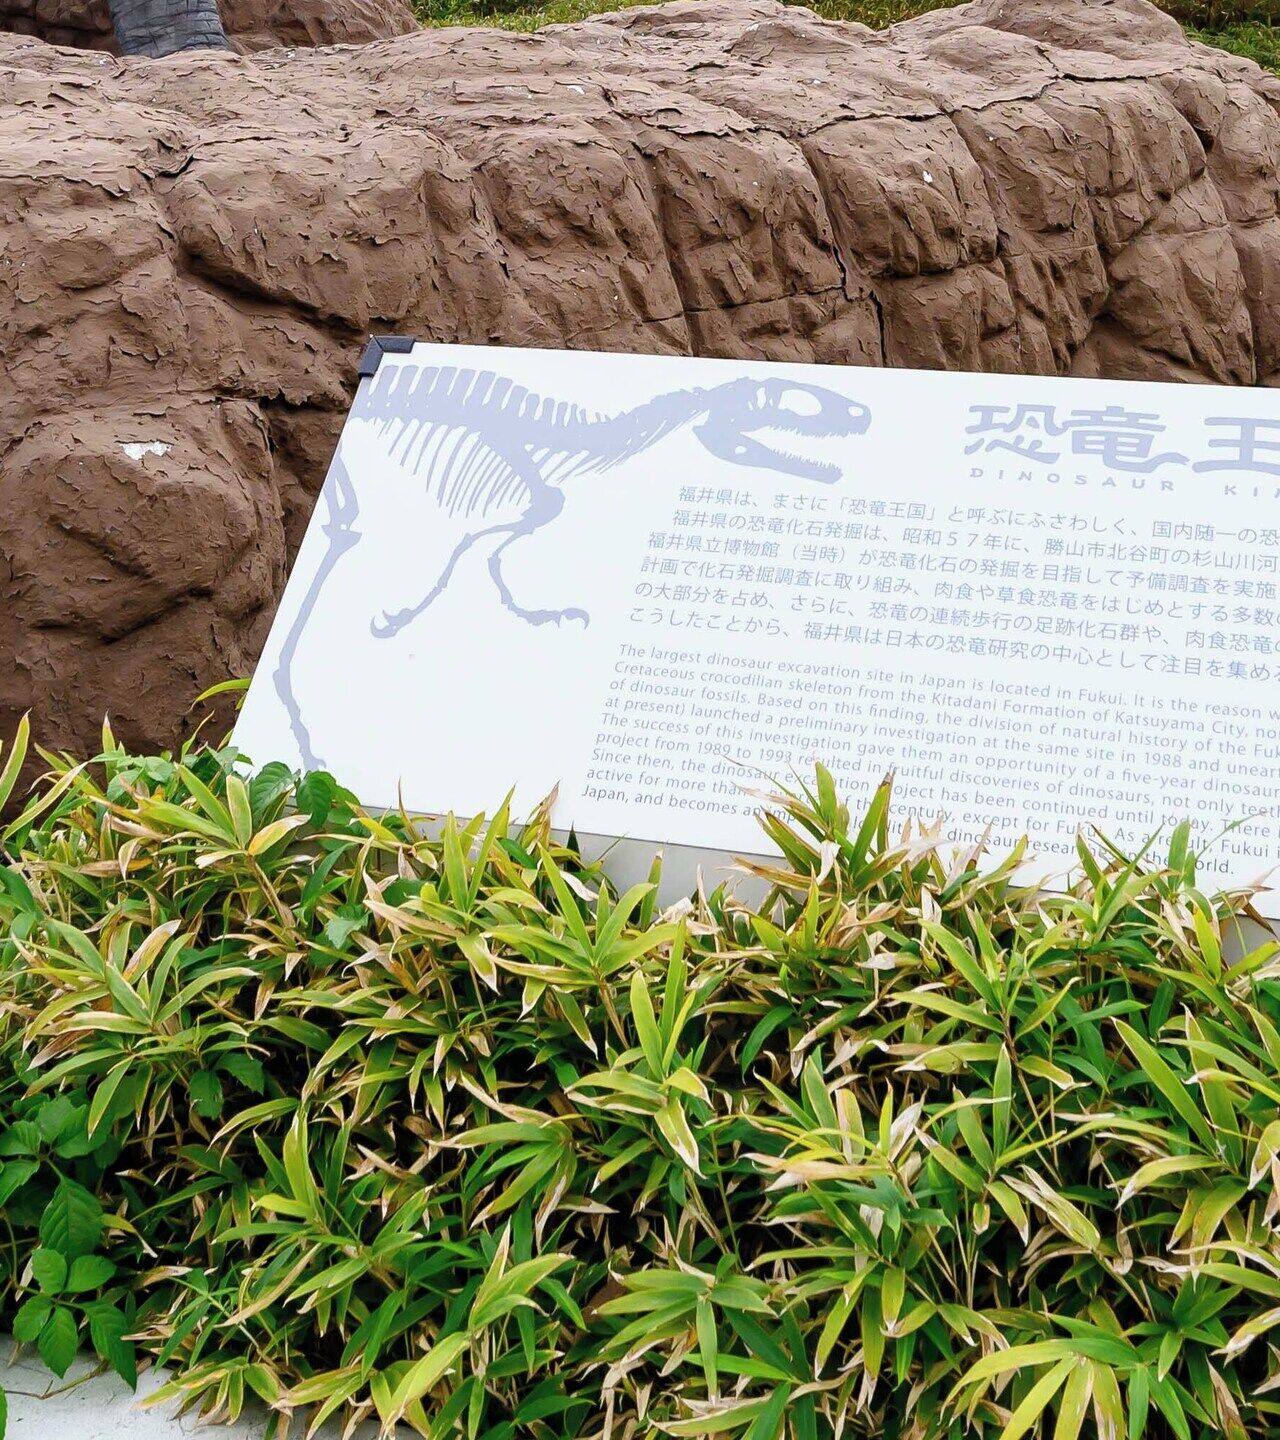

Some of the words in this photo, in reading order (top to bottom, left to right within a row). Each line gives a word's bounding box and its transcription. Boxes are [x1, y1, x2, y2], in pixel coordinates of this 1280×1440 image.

[969, 466, 1176, 492] DINOSAUR
[608, 677, 627, 691] of
[629, 679, 696, 698] dinosaur
[700, 685, 751, 704] fossils.
[756, 691, 803, 711] Based
[807, 699, 828, 713] on
[833, 700, 863, 716] this
[867, 702, 929, 725] finding,
[935, 710, 962, 726] the
[967, 713, 1032, 733] division
[1038, 721, 1058, 736] of
[1061, 726, 1122, 742] natural
[1127, 729, 1188, 752] history
[1192, 736, 1213, 752] of
[1217, 739, 1247, 756] the
[613, 660, 695, 680] Cretaceous
[699, 671, 783, 689] crocodilian
[787, 677, 852, 696] skeleton
[855, 683, 894, 701] from
[900, 688, 926, 704] the
[930, 691, 997, 711] Kitadani
[1002, 698, 1086, 720] Formation
[1091, 707, 1111, 723] of
[1113, 709, 1205, 732] Katsuyama
[1210, 719, 1248, 739] City,
[618, 642, 646, 658] The
[649, 645, 701, 664] largest
[705, 651, 773, 671] dinosaur
[776, 661, 860, 679] excavation
[865, 667, 894, 684] site
[898, 670, 914, 685] in
[918, 672, 966, 690] Japan
[970, 676, 985, 692] is
[989, 678, 1051, 698] located
[1055, 685, 1072, 700] in
[1077, 687, 1127, 706] Fukui.
[1133, 692, 1145, 708] It
[1150, 694, 1164, 710] is
[1169, 696, 1198, 713] the
[1204, 703, 1262, 719] reason
[601, 711, 629, 728] The
[632, 718, 689, 734] success
[693, 722, 713, 737] of
[714, 724, 743, 740] this
[748, 727, 851, 753] investigation
[856, 742, 895, 758] gave
[900, 744, 943, 762] them
[948, 751, 968, 765] an
[974, 754, 1077, 779] opportunity
[1082, 763, 1102, 779] of
[1121, 767, 1196, 789] five-year
[1202, 776, 1280, 798] dinosaur
[603, 695, 621, 709] at
[622, 698, 686, 718] present)
[689, 702, 761, 723] launched
[777, 714, 868, 737] preliminary
[872, 722, 977, 746] investigation
[981, 735, 999, 749] at
[1003, 736, 1031, 752] the
[1035, 742, 1080, 758] same
[1083, 745, 1115, 761] site
[1119, 748, 1136, 764] in
[1144, 751, 1182, 768] 1988
[1187, 757, 1220, 773] and
[580, 783, 629, 804] Japan,
[633, 791, 664, 806] and
[667, 793, 738, 815] becomes
[585, 767, 633, 784] active
[664, 776, 706, 792] more
[888, 803, 955, 826] century,
[961, 811, 1019, 832] except
[1219, 838, 1269, 858] Fukui
[590, 746, 632, 765] Since
[636, 752, 675, 771] then,
[680, 757, 706, 774] the
[939, 785, 968, 803] has
[973, 789, 1016, 808] been
[1021, 798, 1108, 819] continued
[1114, 809, 1154, 824] until
[1218, 817, 1270, 838] There
[594, 731, 649, 748] project
[653, 735, 690, 752] from
[696, 740, 732, 760] 1989
[735, 745, 752, 760] to
[758, 747, 792, 767] 1993
[948, 768, 1040, 792] discoveries
[1044, 779, 1065, 794] of
[1067, 782, 1154, 806] dinosaurs,
[1161, 794, 1191, 809] not
[1195, 797, 1234, 817] only
